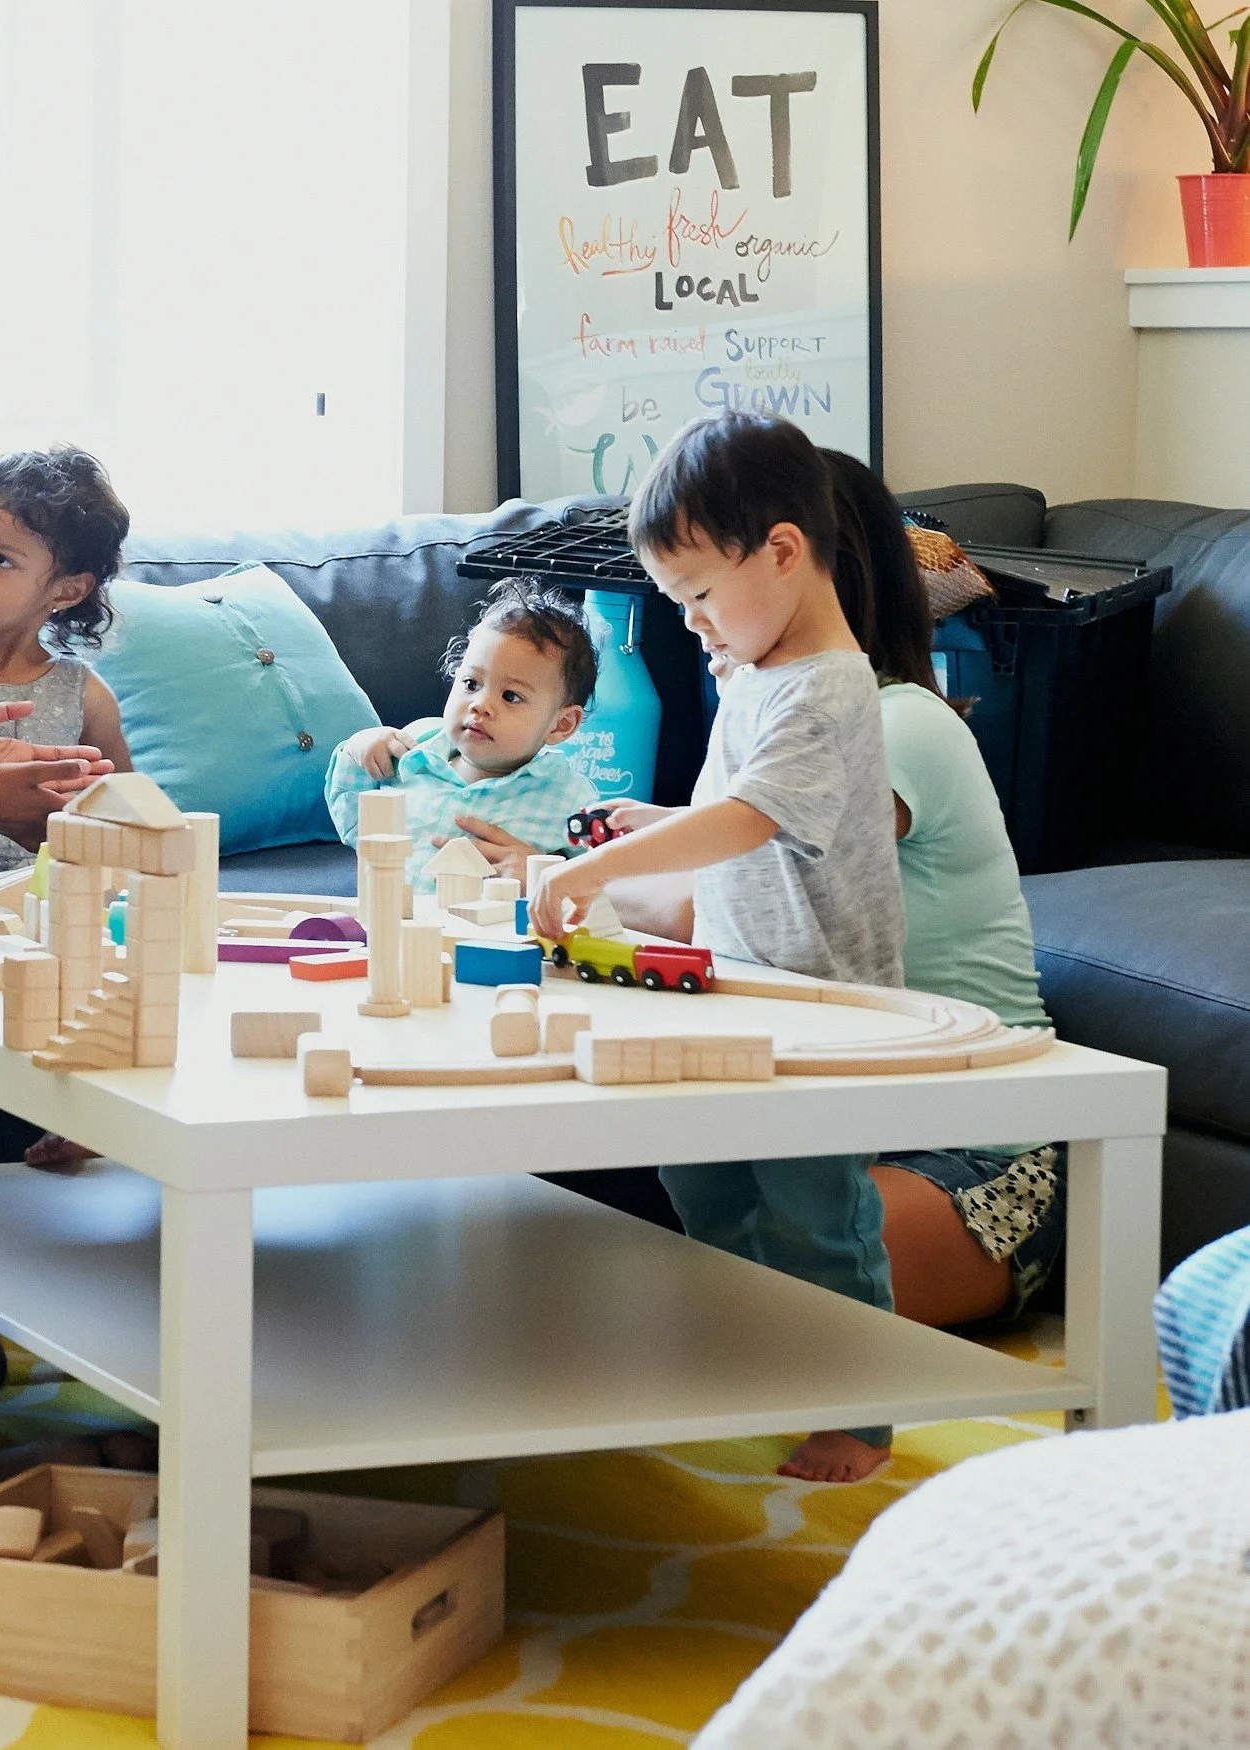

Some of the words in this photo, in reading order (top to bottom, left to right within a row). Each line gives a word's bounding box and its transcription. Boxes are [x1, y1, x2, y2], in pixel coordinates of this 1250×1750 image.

[581, 61, 818, 199] EAT
[558, 215, 657, 276] healthy
[664, 187, 749, 268] fresh
[734, 230, 840, 282] organic
[654, 271, 760, 311] LOCAL
[573, 312, 637, 361] farm
[648, 323, 707, 361] raised
[725, 328, 827, 362] SUPPORT
[621, 385, 662, 424] be
